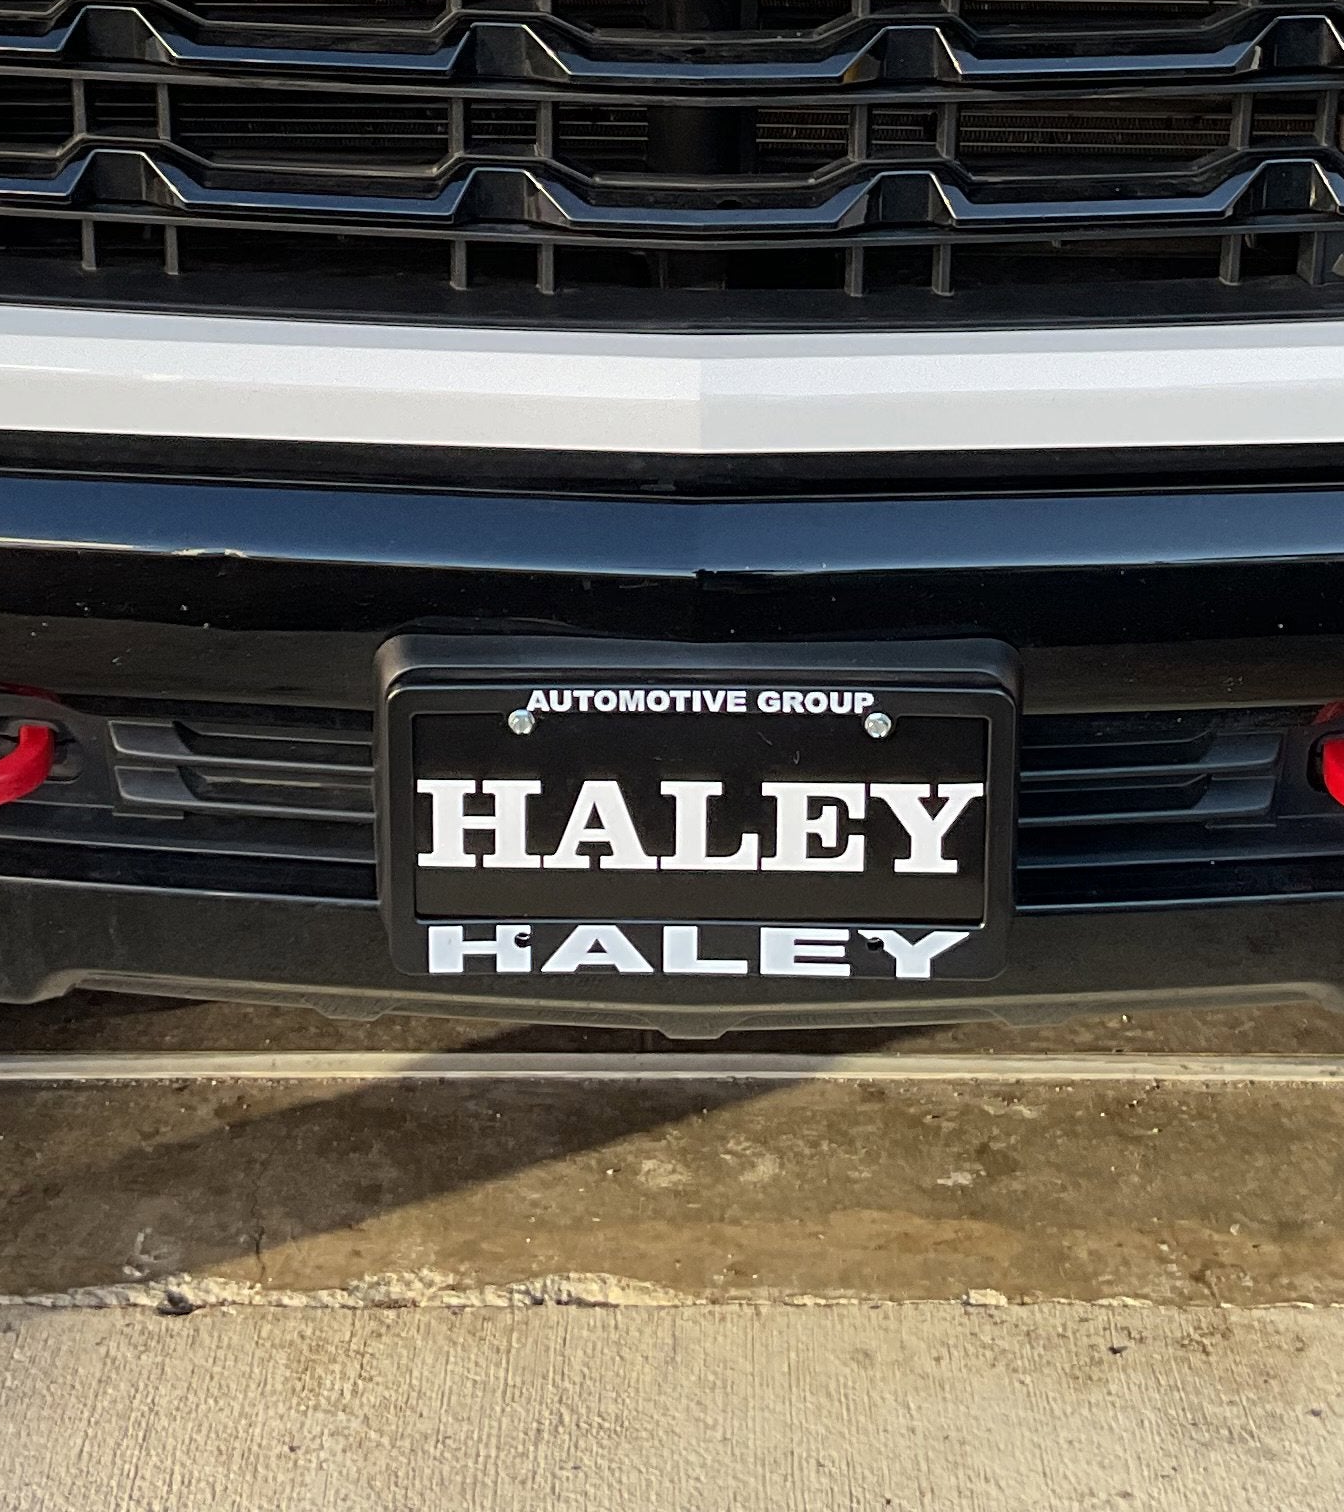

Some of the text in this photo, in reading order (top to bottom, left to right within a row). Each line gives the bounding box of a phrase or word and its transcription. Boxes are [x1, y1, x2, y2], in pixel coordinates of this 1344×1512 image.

[527, 689, 876, 714] AUTOMOTIVE GROUP
[416, 778, 986, 875] HALEY
[427, 924, 971, 980] HALEY
